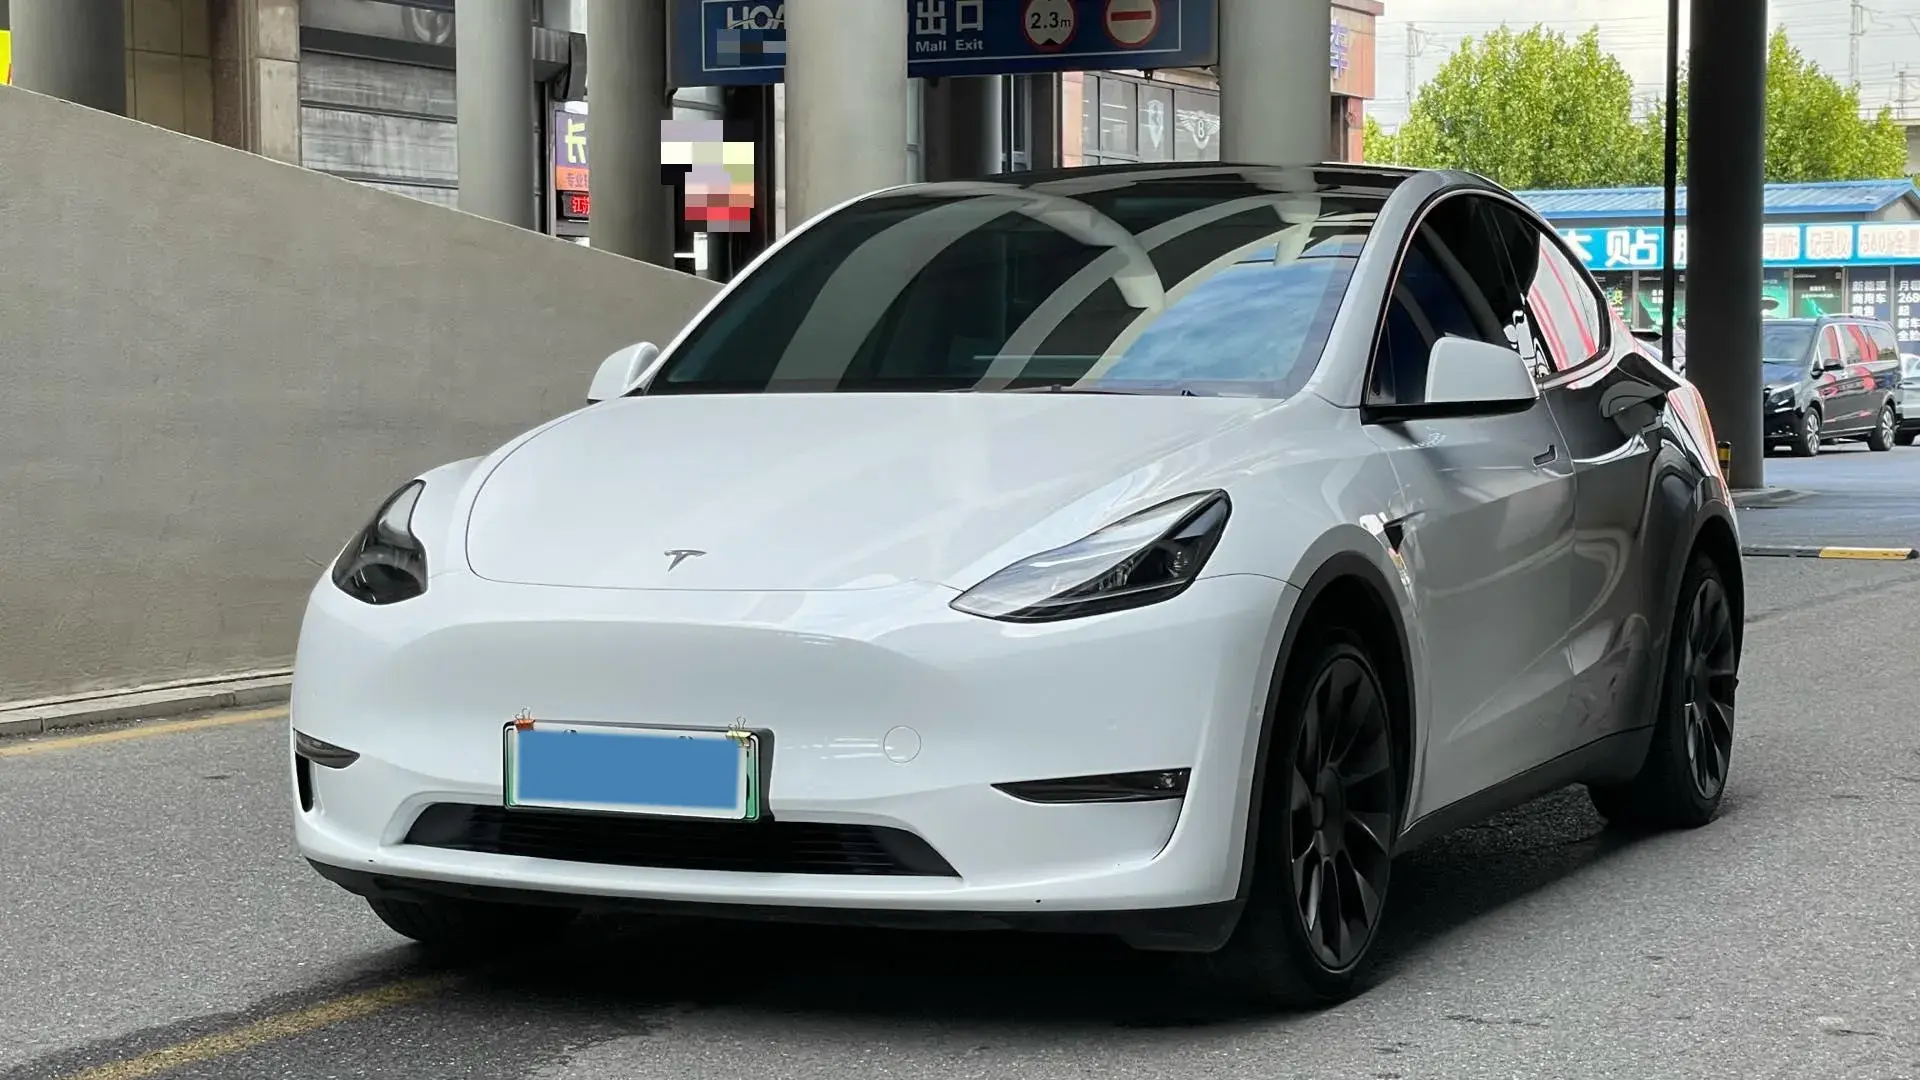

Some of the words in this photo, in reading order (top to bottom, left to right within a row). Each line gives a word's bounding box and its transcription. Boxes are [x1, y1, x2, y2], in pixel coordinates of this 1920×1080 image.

[916, 0, 984, 35] 出口
[1031, 12, 1071, 29] 2.3m
[916, 40, 947, 52] Mall
[955, 39, 984, 51] Exit
